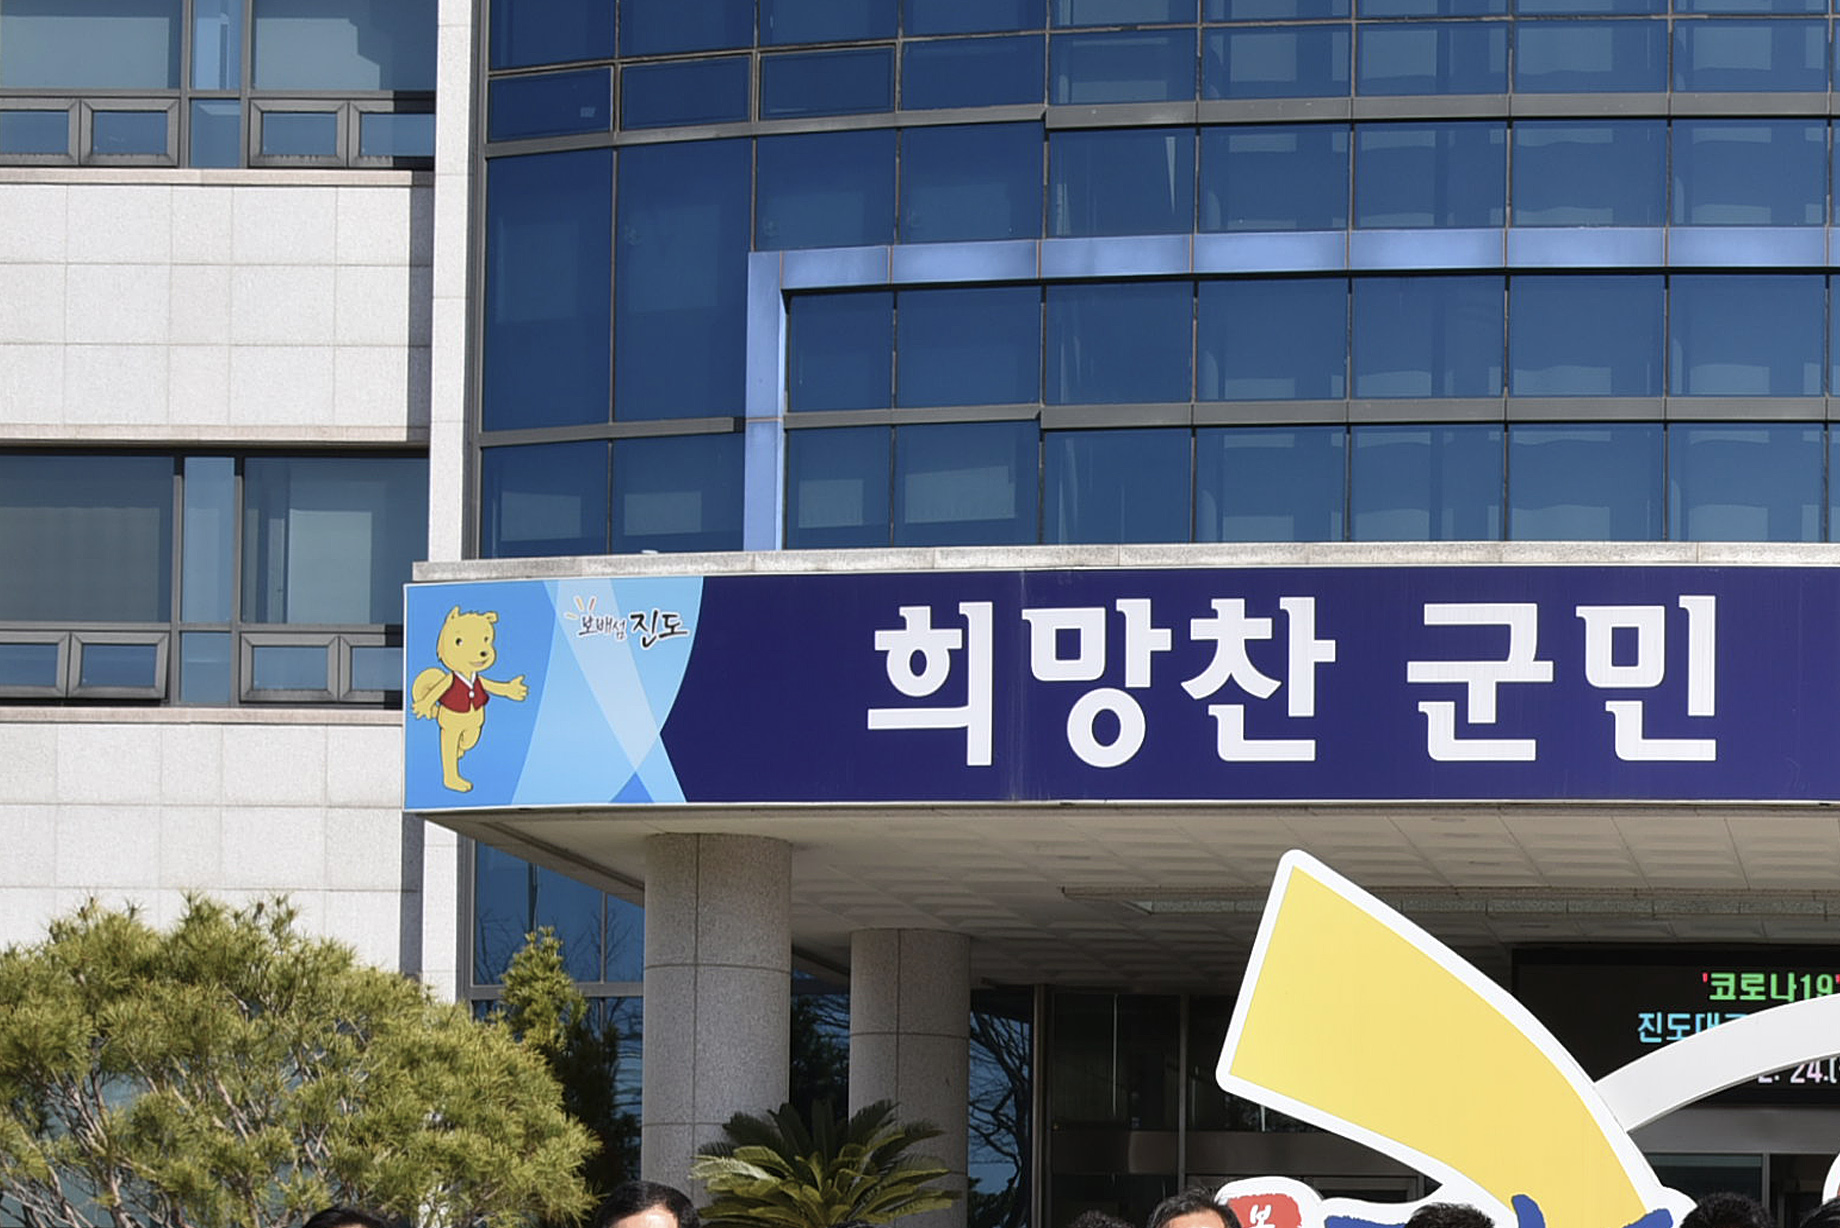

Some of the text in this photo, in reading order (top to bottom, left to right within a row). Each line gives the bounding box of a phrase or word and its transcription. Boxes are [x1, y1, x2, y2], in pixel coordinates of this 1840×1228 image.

[578, 609, 689, 648] 보배섬 진도
[867, 596, 1336, 768] 희망찬
[1407, 595, 1716, 761] 군민
